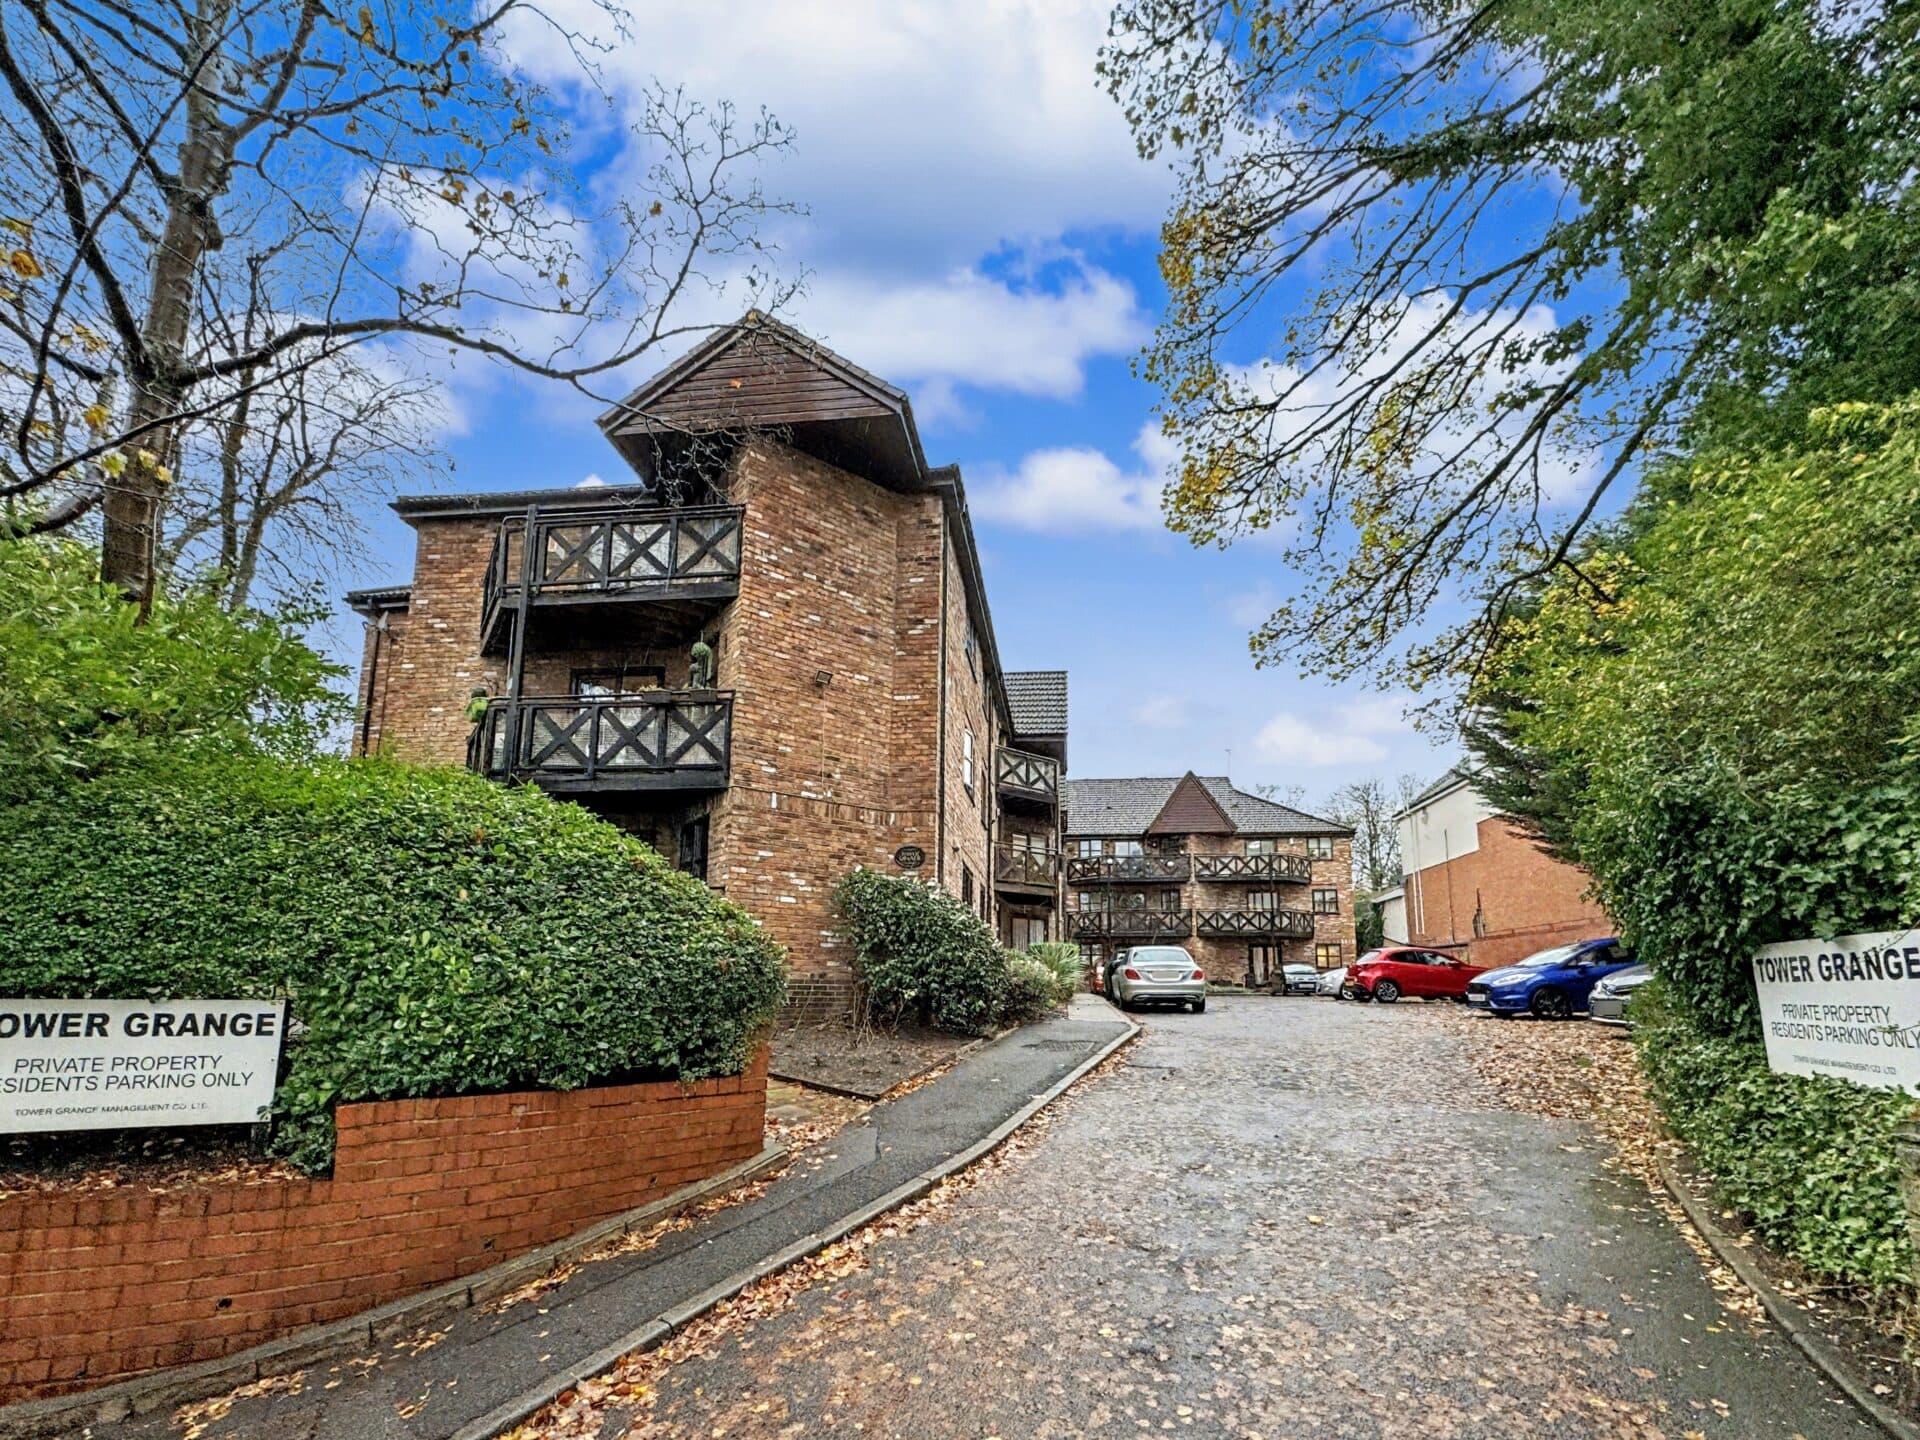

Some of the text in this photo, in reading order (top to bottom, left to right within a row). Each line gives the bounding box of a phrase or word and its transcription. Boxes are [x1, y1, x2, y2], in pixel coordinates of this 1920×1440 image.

[1756, 947, 1920, 983] TOWER GRANGE
[1782, 1004, 1890, 1024] PRIVATE PROPERTY
[124, 1012, 276, 1037] GRANGE
[1771, 1021, 1824, 1041] RESIDENTS
[1825, 1026, 1879, 1046] PARKING
[14, 1055, 222, 1074] PRIVATE PROPERTY
[105, 1073, 195, 1090] PARKING
[202, 1071, 253, 1088] ONLY
[15, 1108, 52, 1117] TOWER
